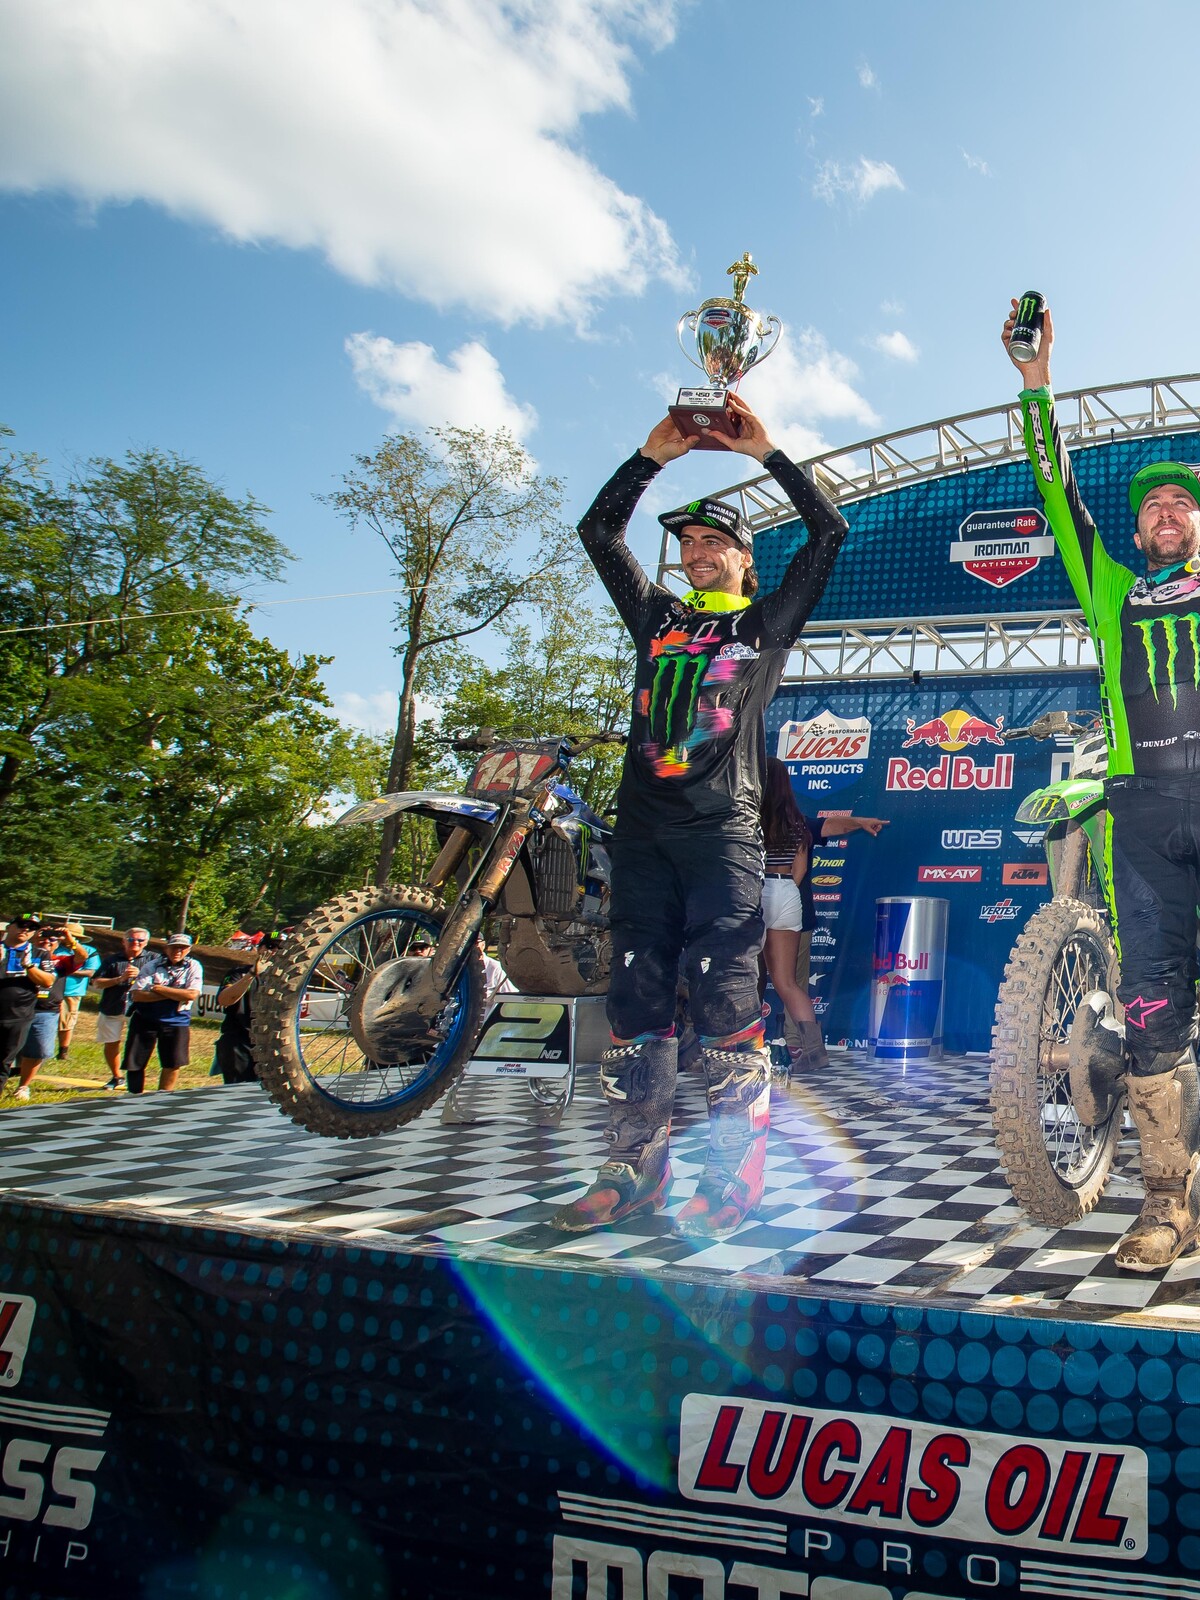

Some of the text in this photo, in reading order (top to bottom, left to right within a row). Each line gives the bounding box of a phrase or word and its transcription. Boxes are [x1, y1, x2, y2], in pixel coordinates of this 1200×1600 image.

[1137, 472, 1191, 487] Kawasaki
[713, 506, 737, 520] YAMAHA
[966, 518, 1037, 532] guaranteed Rate
[974, 542, 1030, 557] IRONMAN
[972, 560, 1031, 569] NATIONAL
[784, 735, 865, 760] LUCAS
[1142, 736, 1178, 748] DUNLOP
[801, 763, 864, 776] PRODUCTS
[886, 753, 1015, 790] Red Bull
[807, 778, 832, 790] INC.
[941, 829, 1002, 850] WPS
[820, 859, 846, 867] THOR
[1010, 868, 1040, 880] KTM
[981, 905, 1021, 916] VERTEX
[895, 953, 929, 970] Bull
[473, 1003, 565, 1059] 2
[540, 1050, 563, 1060] ND
[694, 1405, 1130, 1548] LUCAS OIL
[0, 1438, 107, 1531] SS
[804, 1529, 1001, 1587] PRO
